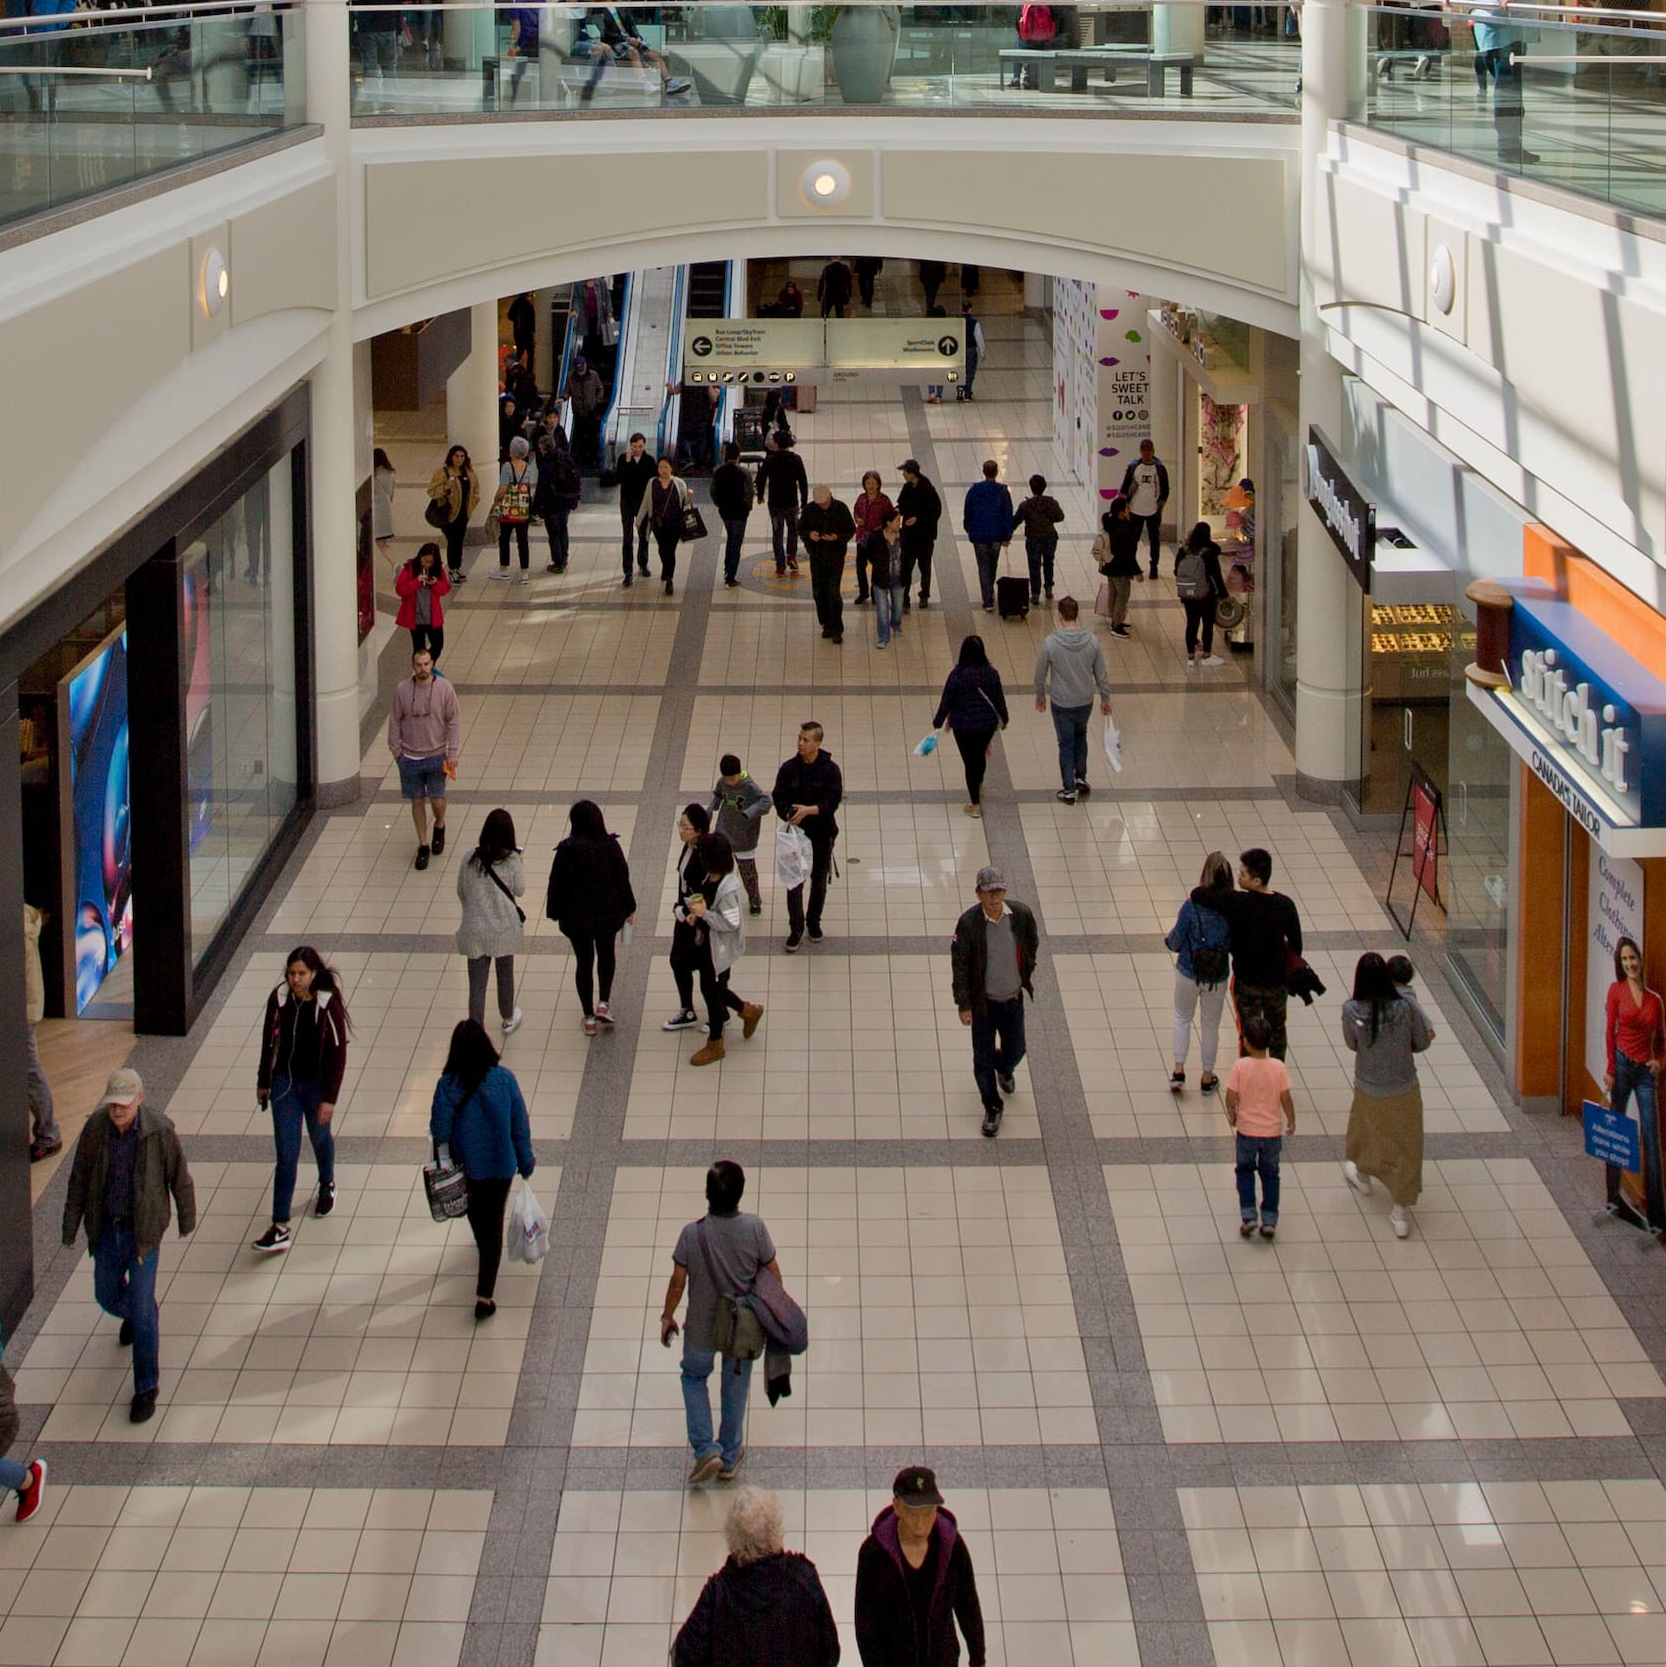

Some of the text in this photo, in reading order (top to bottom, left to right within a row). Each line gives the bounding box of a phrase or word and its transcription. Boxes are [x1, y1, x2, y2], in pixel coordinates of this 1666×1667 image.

[1111, 383, 1150, 394] SWEET
[1115, 371, 1146, 382] LET'S
[1117, 395, 1145, 405] TALK
[1521, 648, 1629, 793] stitch it
[1532, 750, 1601, 840] CANADA'S TAILOR
[1598, 855, 1636, 911] Complete
